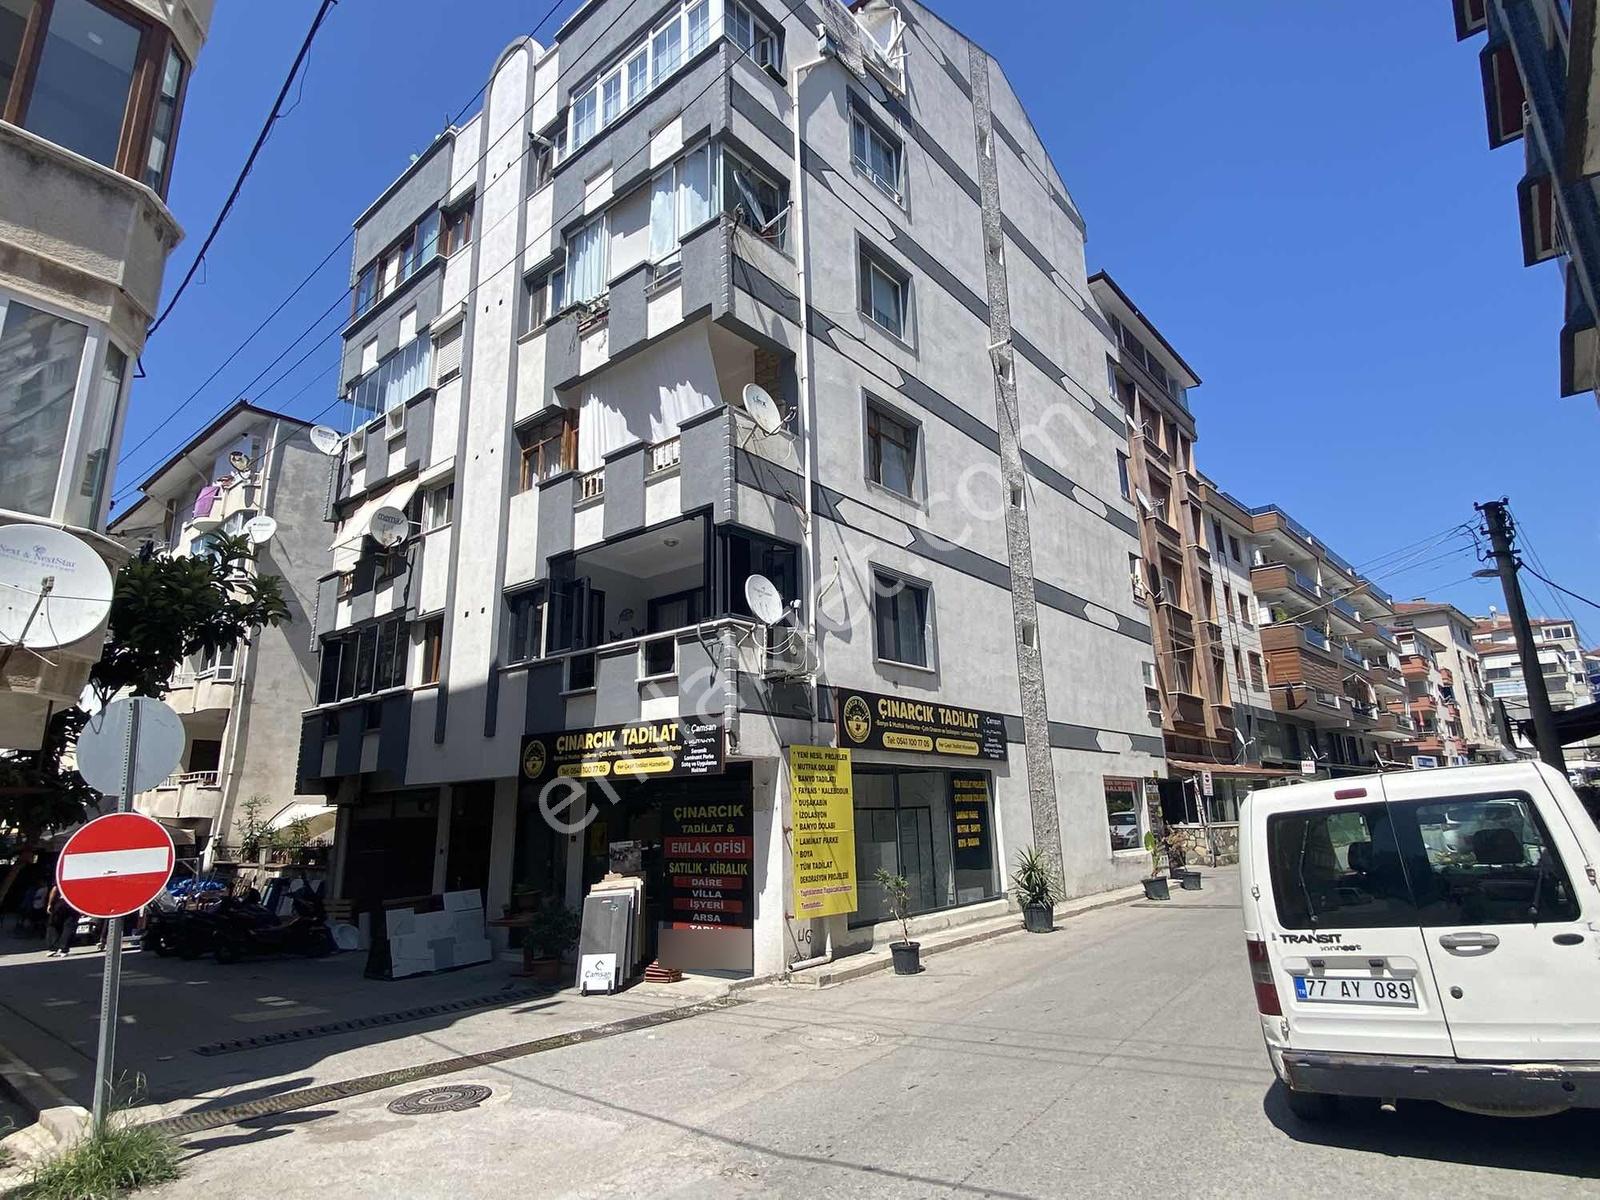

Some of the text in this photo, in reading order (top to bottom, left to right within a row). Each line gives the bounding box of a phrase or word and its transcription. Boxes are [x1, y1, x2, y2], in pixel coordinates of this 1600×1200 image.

[878, 698, 934, 723] ÇINARCIK
[690, 723, 717, 734] Çamsan
[556, 730, 616, 755] ÇINARCIK
[673, 804, 745, 821] ÇINARCIK
[681, 823, 736, 833] TADİLAT &
[822, 836, 839, 844] PARKE
[671, 839, 746, 854] EMLAK OFİSİ
[799, 850, 813, 858] BOYA
[669, 862, 702, 874] SATILIK
[709, 861, 748, 875] KİRALIK
[691, 877, 723, 887] DAİRE
[690, 899, 724, 910] İŞYERİ
[692, 913, 721, 922] ARSA
[1280, 933, 1342, 944] TRANSIT
[1306, 980, 1328, 997] 77
[1341, 981, 1361, 998] AY
[1374, 981, 1411, 1000] 089
